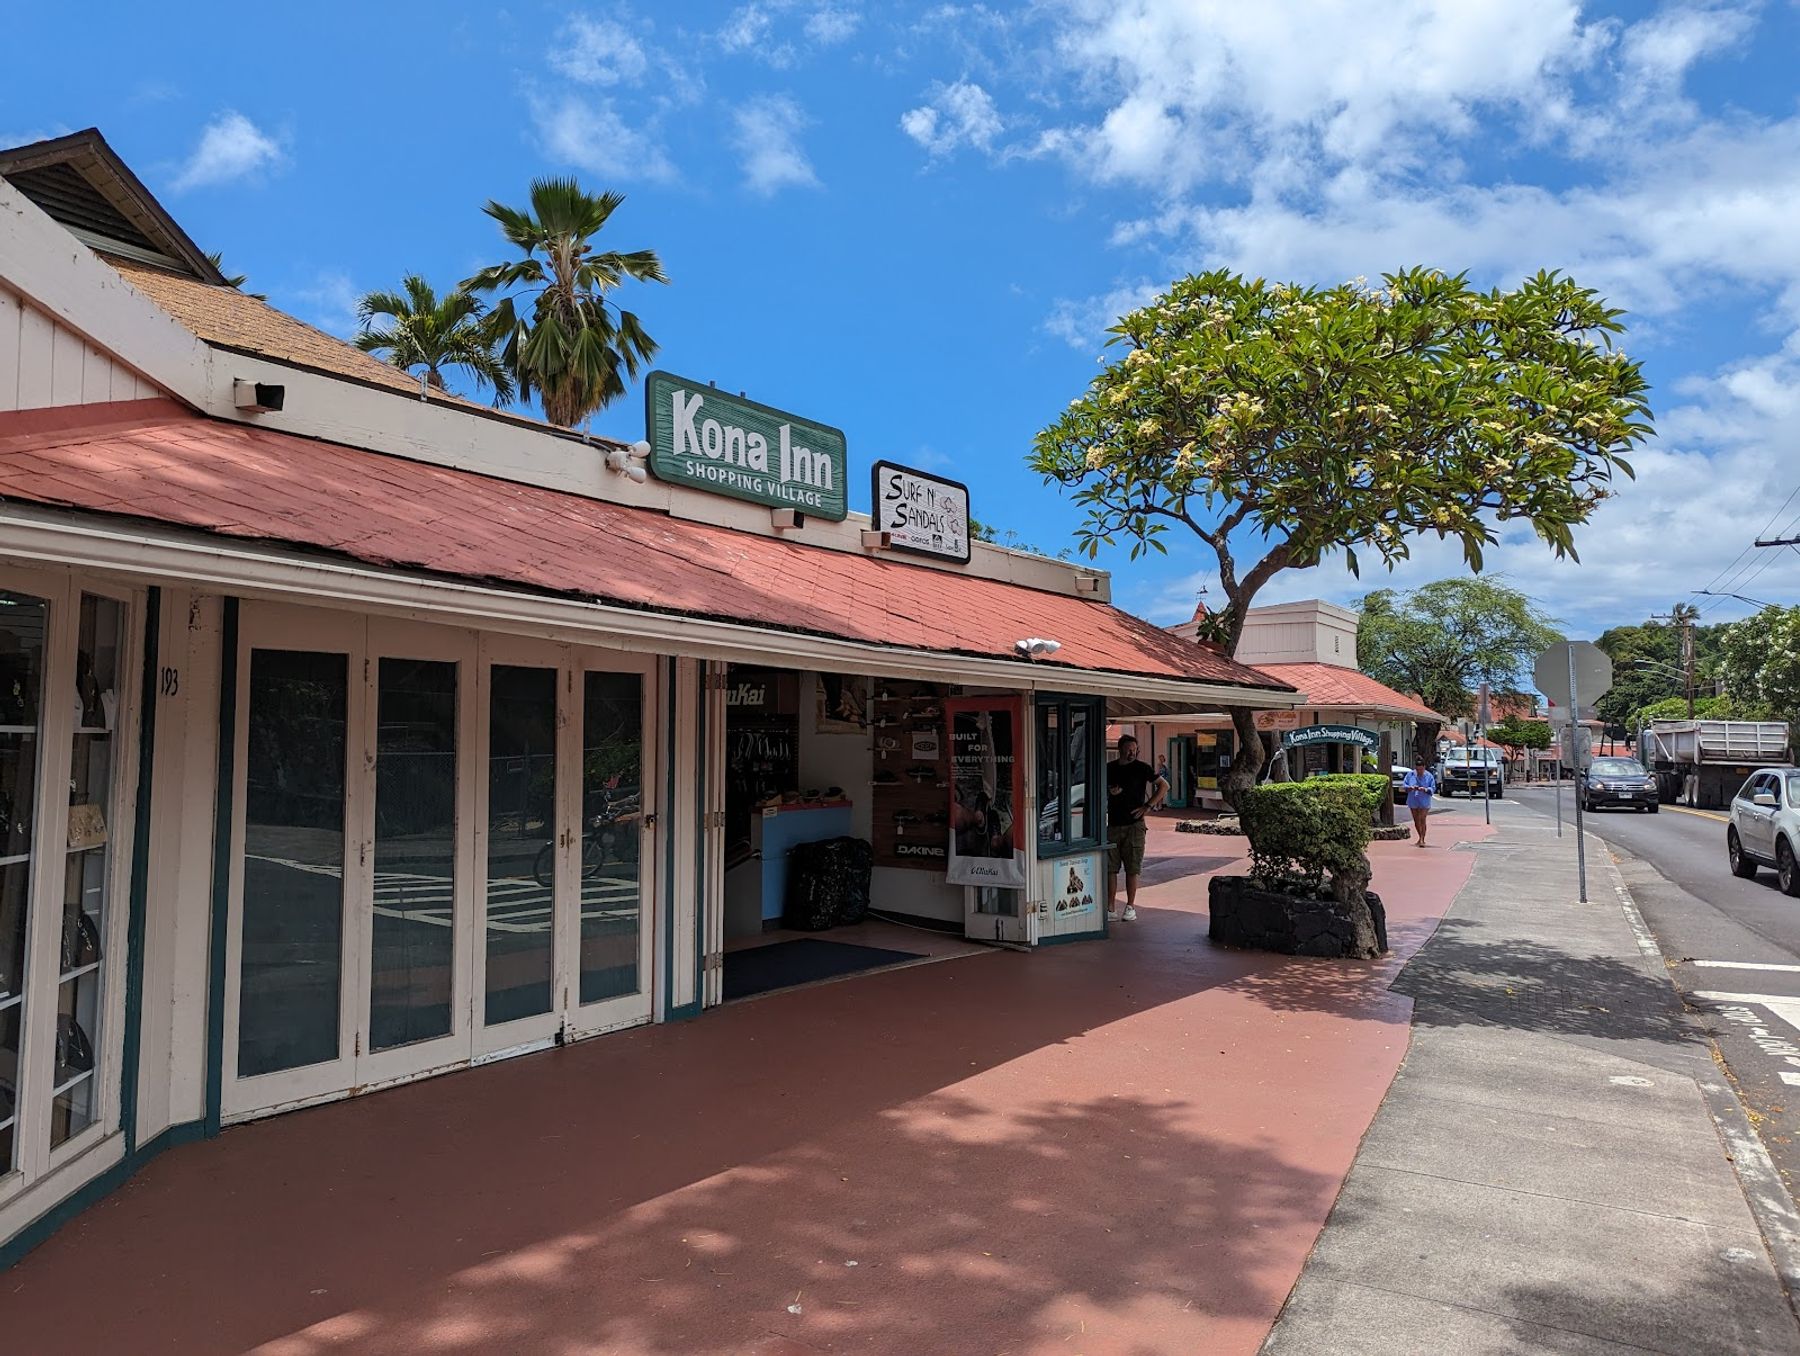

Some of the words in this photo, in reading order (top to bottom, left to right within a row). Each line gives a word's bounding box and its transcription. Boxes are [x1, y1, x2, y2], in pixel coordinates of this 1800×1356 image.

[671, 389, 768, 473] Kona
[778, 423, 833, 490] Inn
[686, 460, 762, 493] SHOPPING
[767, 481, 822, 508] VILLAGE
[885, 474, 923, 504] SURF
[890, 503, 945, 534] SANDALS
[161, 666, 178, 697] 193
[949, 733, 978, 741] BUILT
[968, 744, 988, 752] FOR
[1289, 731, 1308, 744] Kona
[1307, 728, 1321, 740] Inn
[1321, 727, 1352, 741] Shopping
[1351, 730, 1374, 745] Village
[951, 755, 1016, 764] EVERYTHING
